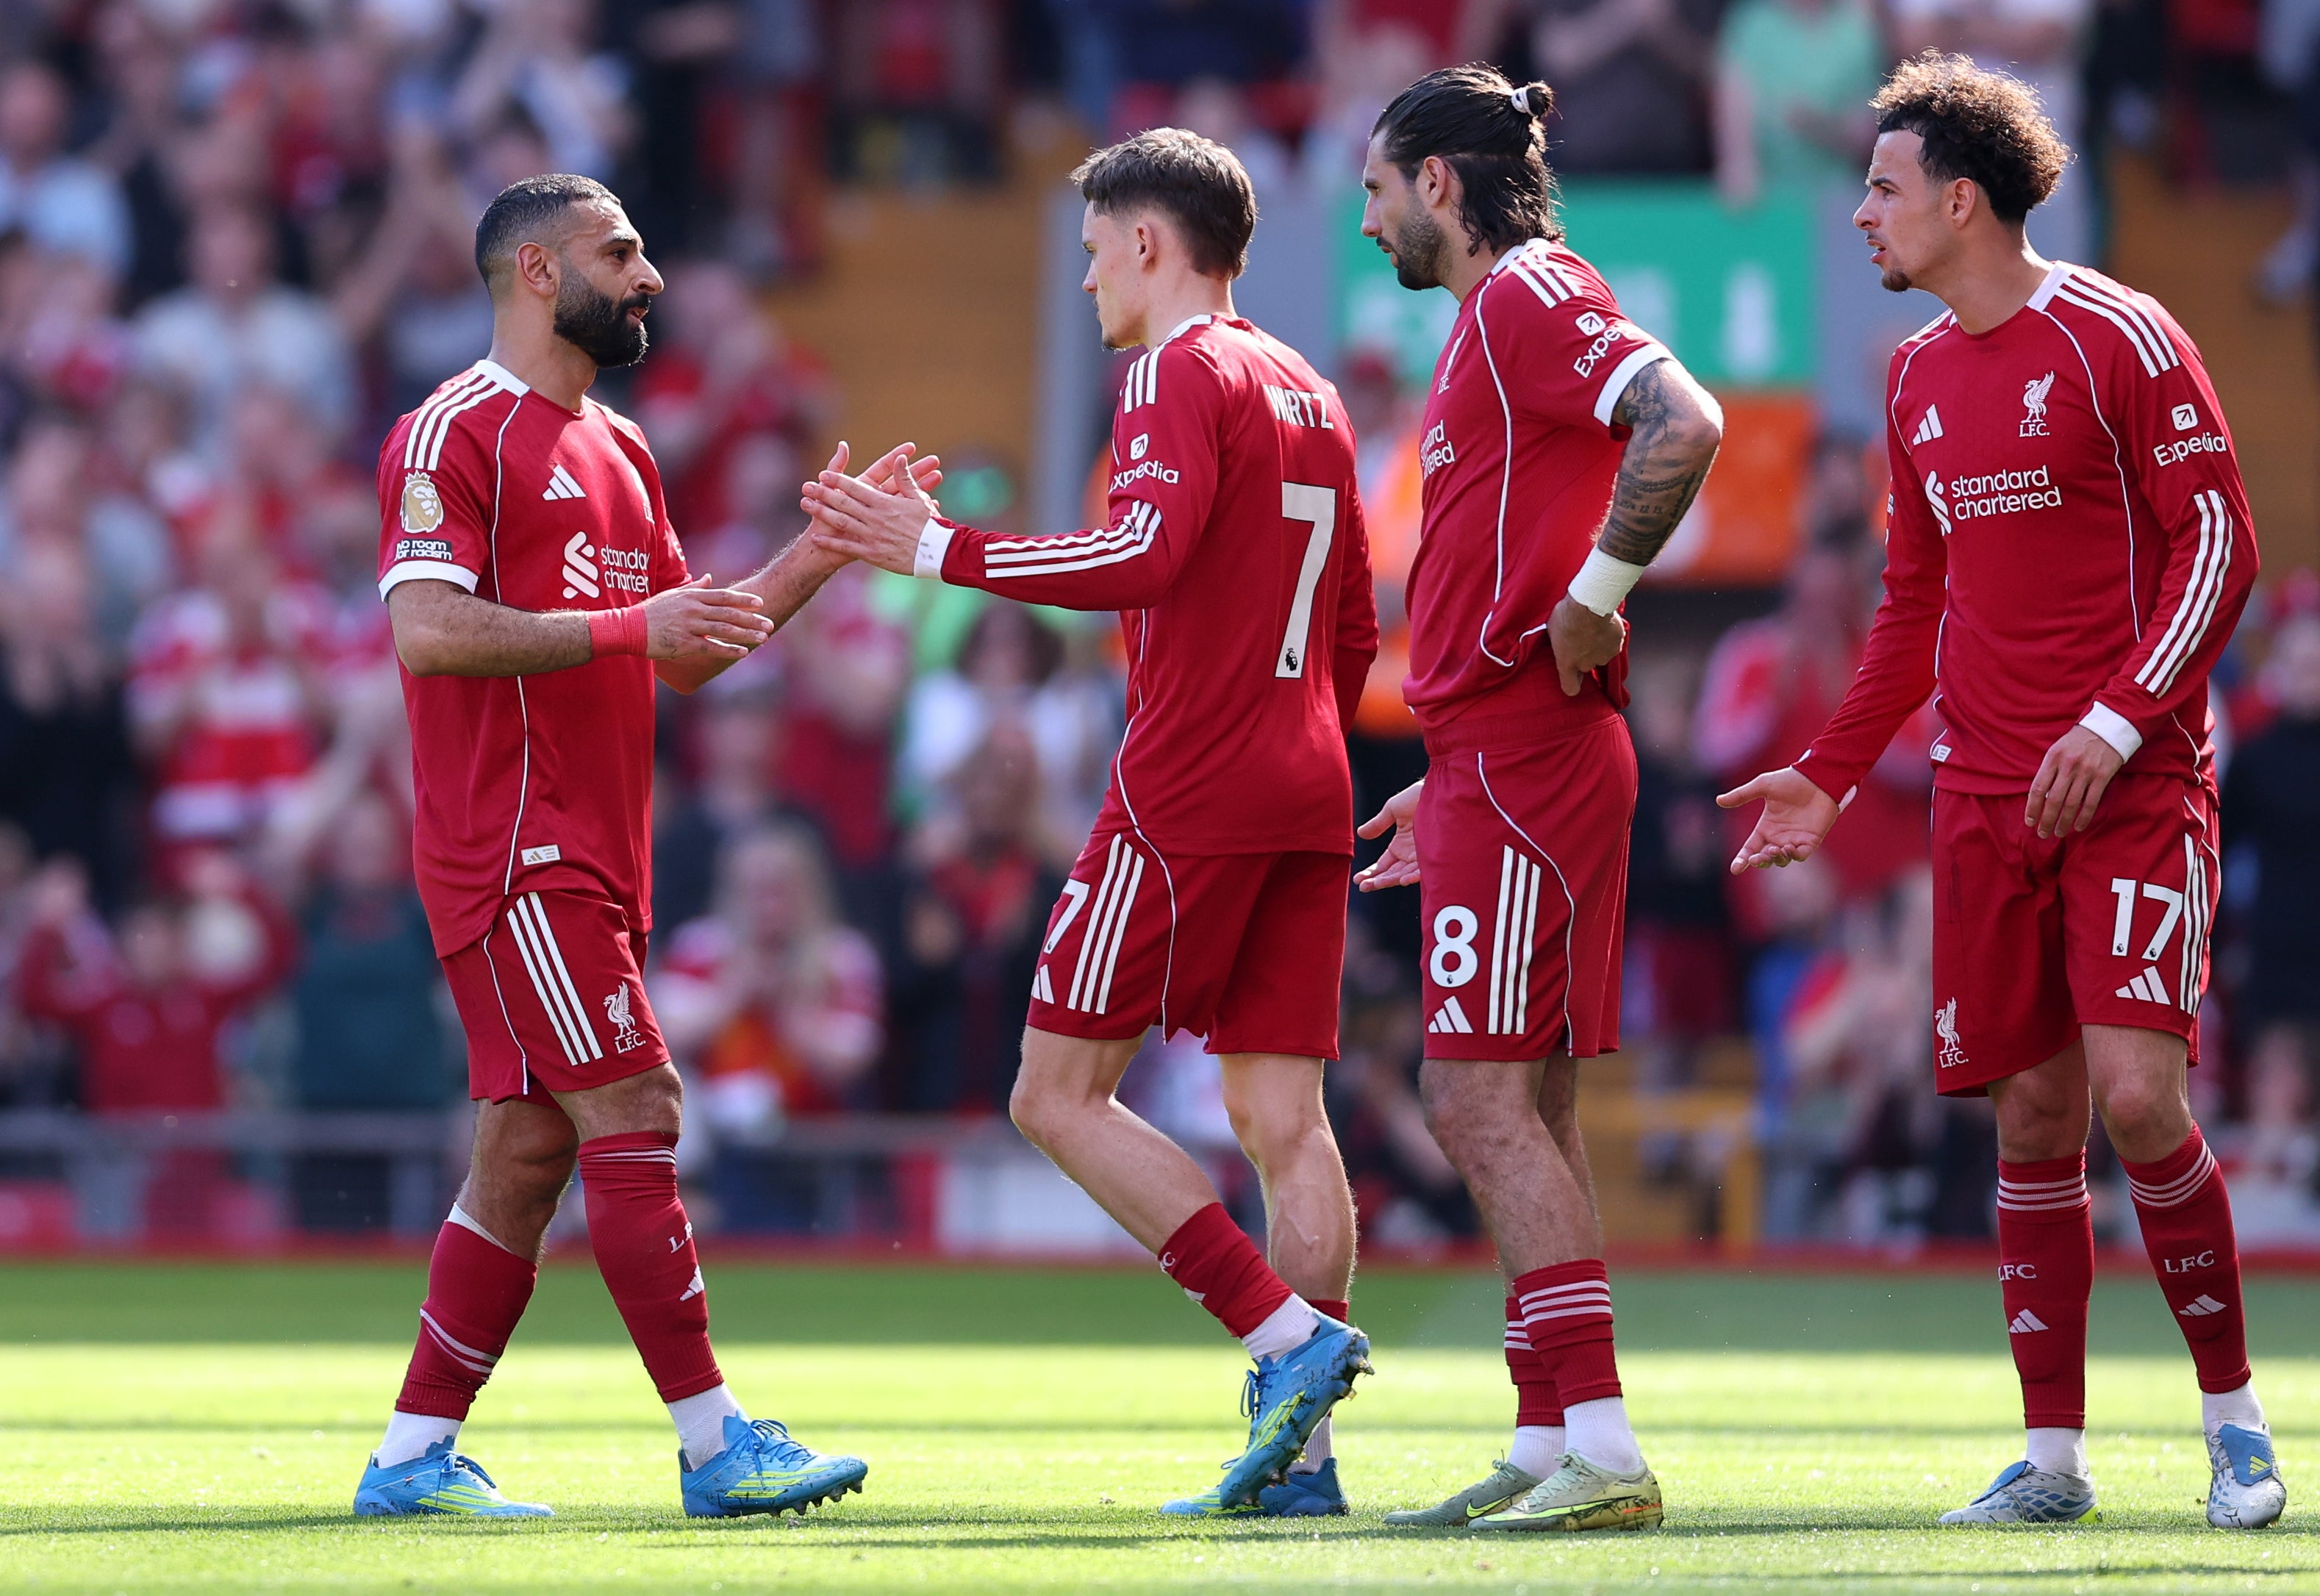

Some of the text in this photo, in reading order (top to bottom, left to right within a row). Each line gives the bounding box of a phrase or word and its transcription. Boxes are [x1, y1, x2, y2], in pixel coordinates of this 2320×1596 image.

[2152, 432, 2227, 467] Expedia
[1950, 465, 2049, 498] standard
[1955, 486, 2063, 520] chartered
[410, 549, 452, 561] racism
[1275, 481, 1336, 679] 7
[1043, 878, 1091, 955] 7
[2110, 877, 2184, 962] 17
[1429, 904, 1478, 988] 8
[2163, 1250, 2215, 1273] LFC
